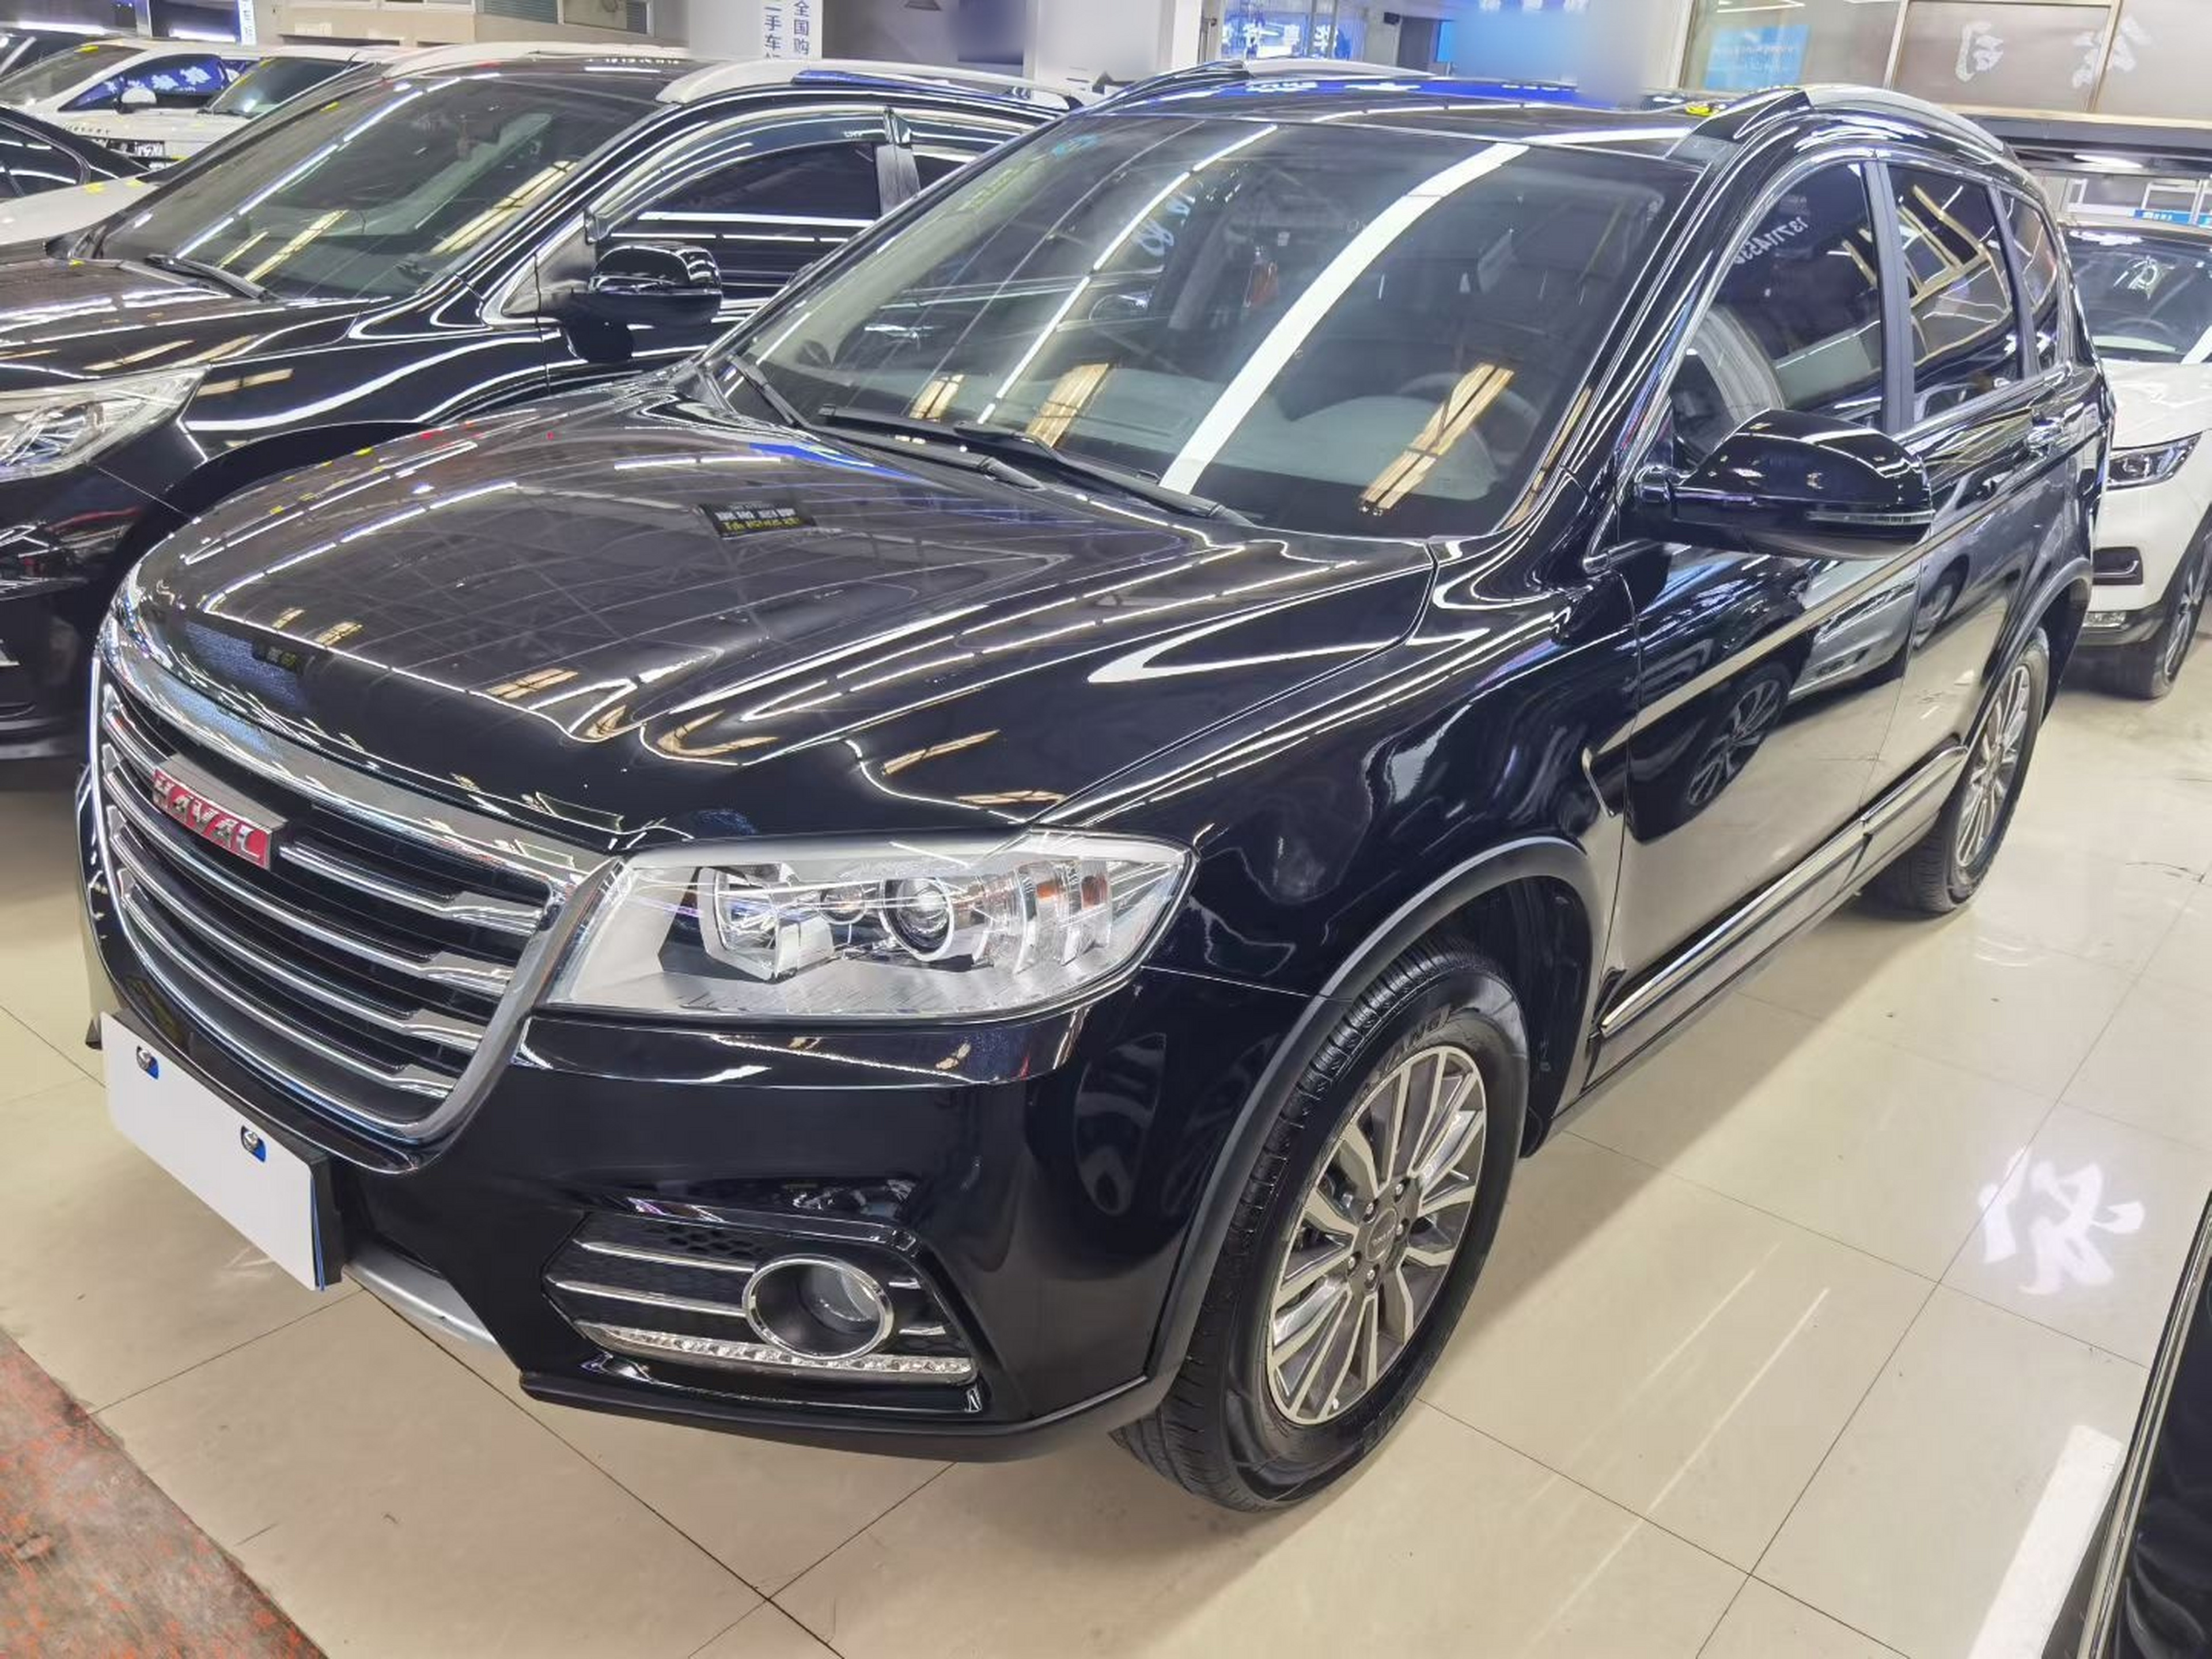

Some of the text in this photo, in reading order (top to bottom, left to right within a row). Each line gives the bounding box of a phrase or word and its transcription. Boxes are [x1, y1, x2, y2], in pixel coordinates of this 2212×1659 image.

[793, 1, 810, 55] 全国购
[153, 777, 262, 859] HAVAL
